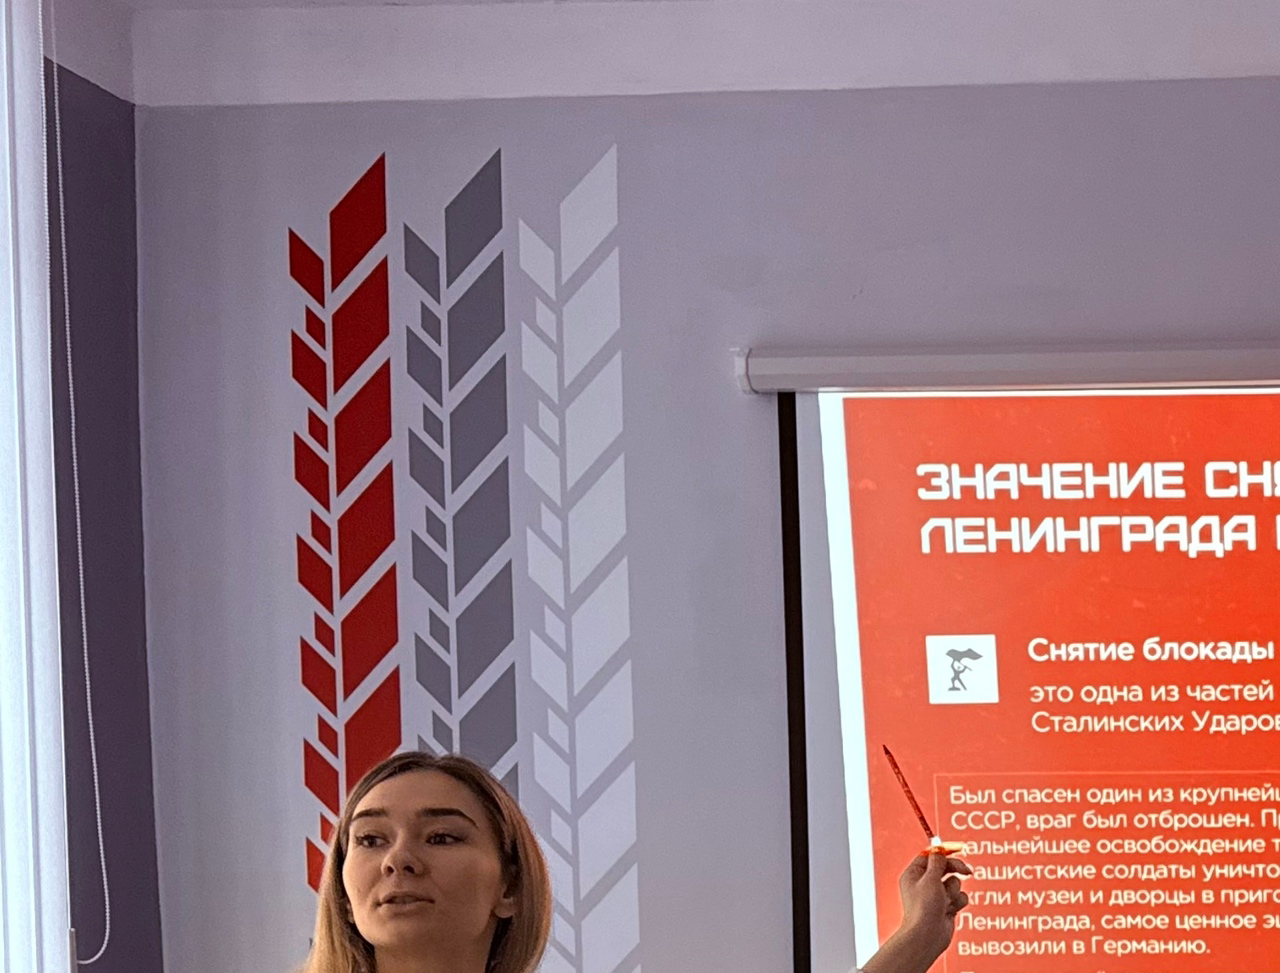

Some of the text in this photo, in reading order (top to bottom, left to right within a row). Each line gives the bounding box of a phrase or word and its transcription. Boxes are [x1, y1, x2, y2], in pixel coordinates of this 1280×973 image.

[915, 461, 1186, 501] ЗНАЧЕНИЕ
[920, 514, 1257, 559] ЛЕНИНГРАДА
[1027, 637, 1135, 662] Снятие
[1142, 636, 1275, 664] блокады
[1029, 685, 1074, 703] это
[1079, 685, 1143, 705] одна
[1150, 684, 1180, 702] из
[1186, 679, 1274, 702] частей
[1031, 710, 1185, 733] Сталинских
[949, 785, 996, 805] Был
[1001, 788, 1081, 804] спасен
[1086, 788, 1142, 805] один
[1148, 787, 1175, 803] из
[950, 810, 1021, 831] СССР,
[1026, 813, 1077, 832] враг
[1082, 809, 1128, 829] был
[1133, 809, 1255, 832] отброшен.
[1095, 835, 1266, 856] освобождение
[1101, 864, 1196, 881] солдаты
[1017, 889, 1085, 908] музеи
[1089, 889, 1104, 904] и
[1108, 889, 1196, 907] дворцы
[1201, 889, 1215, 904] в
[956, 912, 1096, 934] Ленинграда,
[1100, 914, 1170, 930] самое
[1175, 914, 1257, 931] ценное
[957, 935, 1211, 957] вывозили в Германию.
